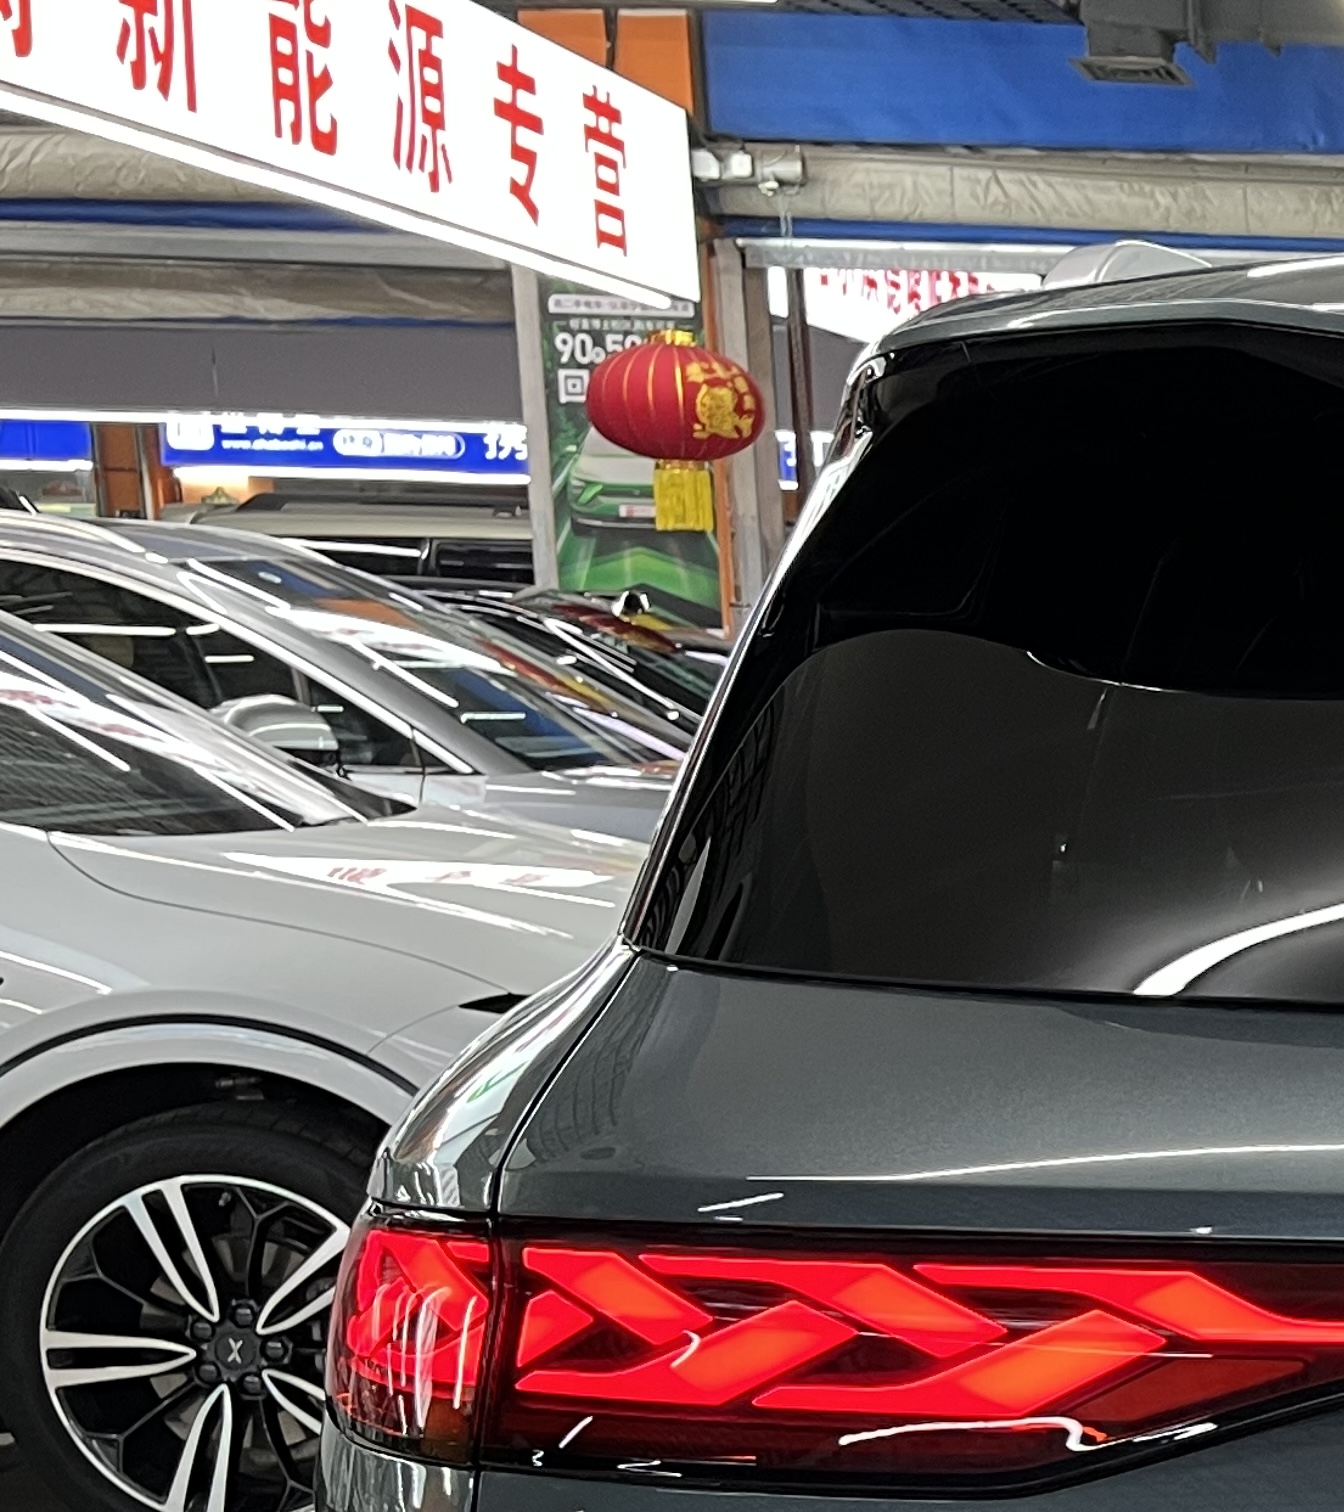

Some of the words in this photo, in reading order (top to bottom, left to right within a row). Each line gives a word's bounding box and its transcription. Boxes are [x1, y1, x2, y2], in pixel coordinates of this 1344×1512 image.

[0, 0, 629, 258] 新能源专营
